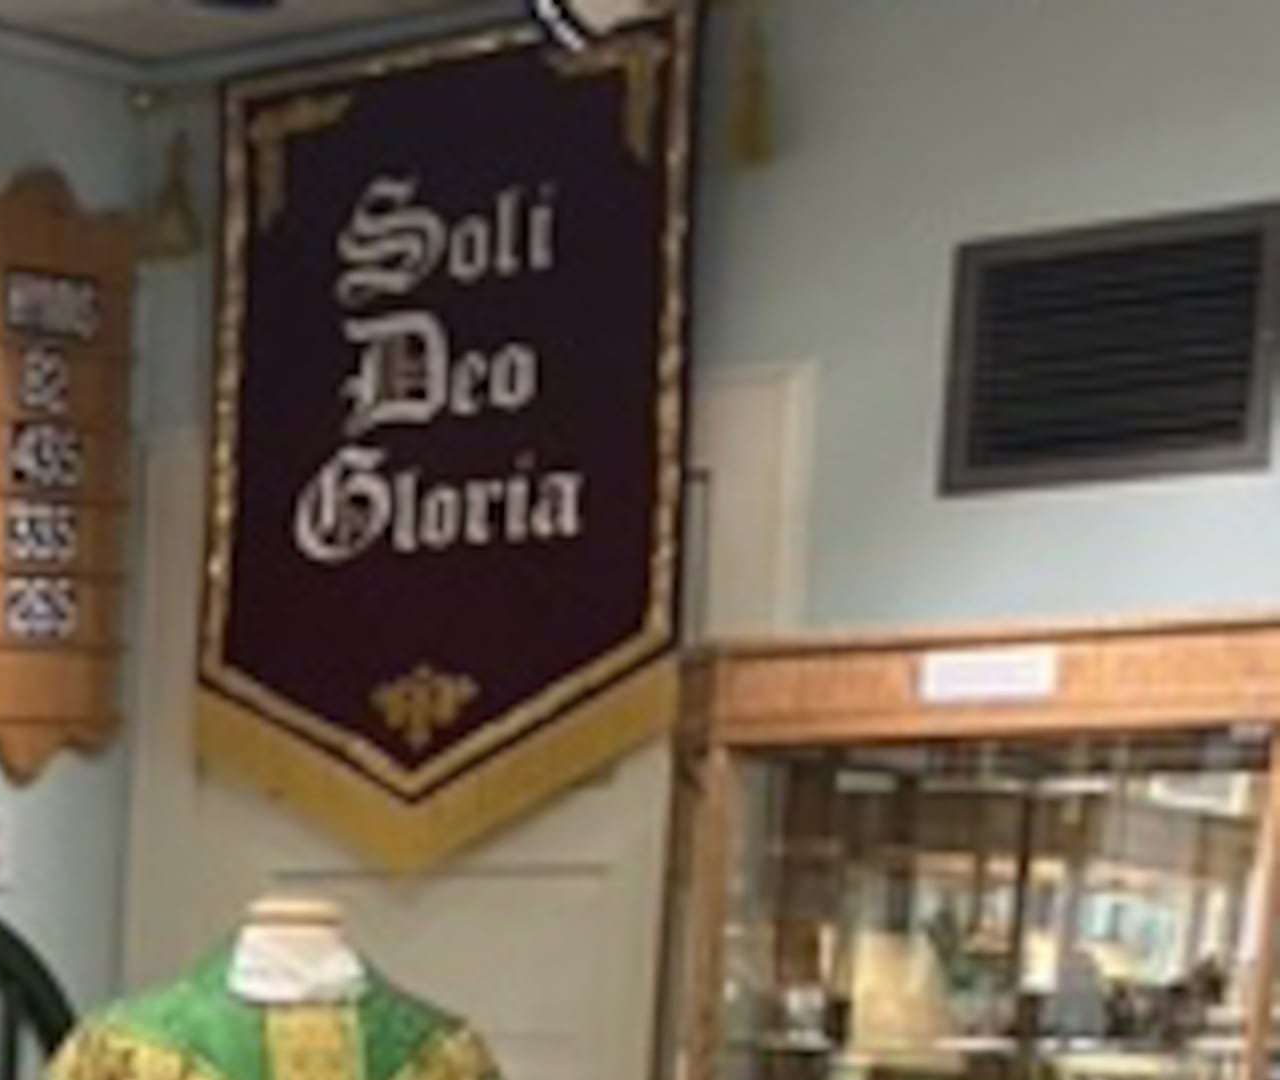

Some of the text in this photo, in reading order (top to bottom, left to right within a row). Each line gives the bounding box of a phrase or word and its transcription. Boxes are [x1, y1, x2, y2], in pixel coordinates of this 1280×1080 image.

[336, 173, 556, 306] Soli
[342, 308, 538, 437] Deo
[294, 446, 584, 562] Gloria
